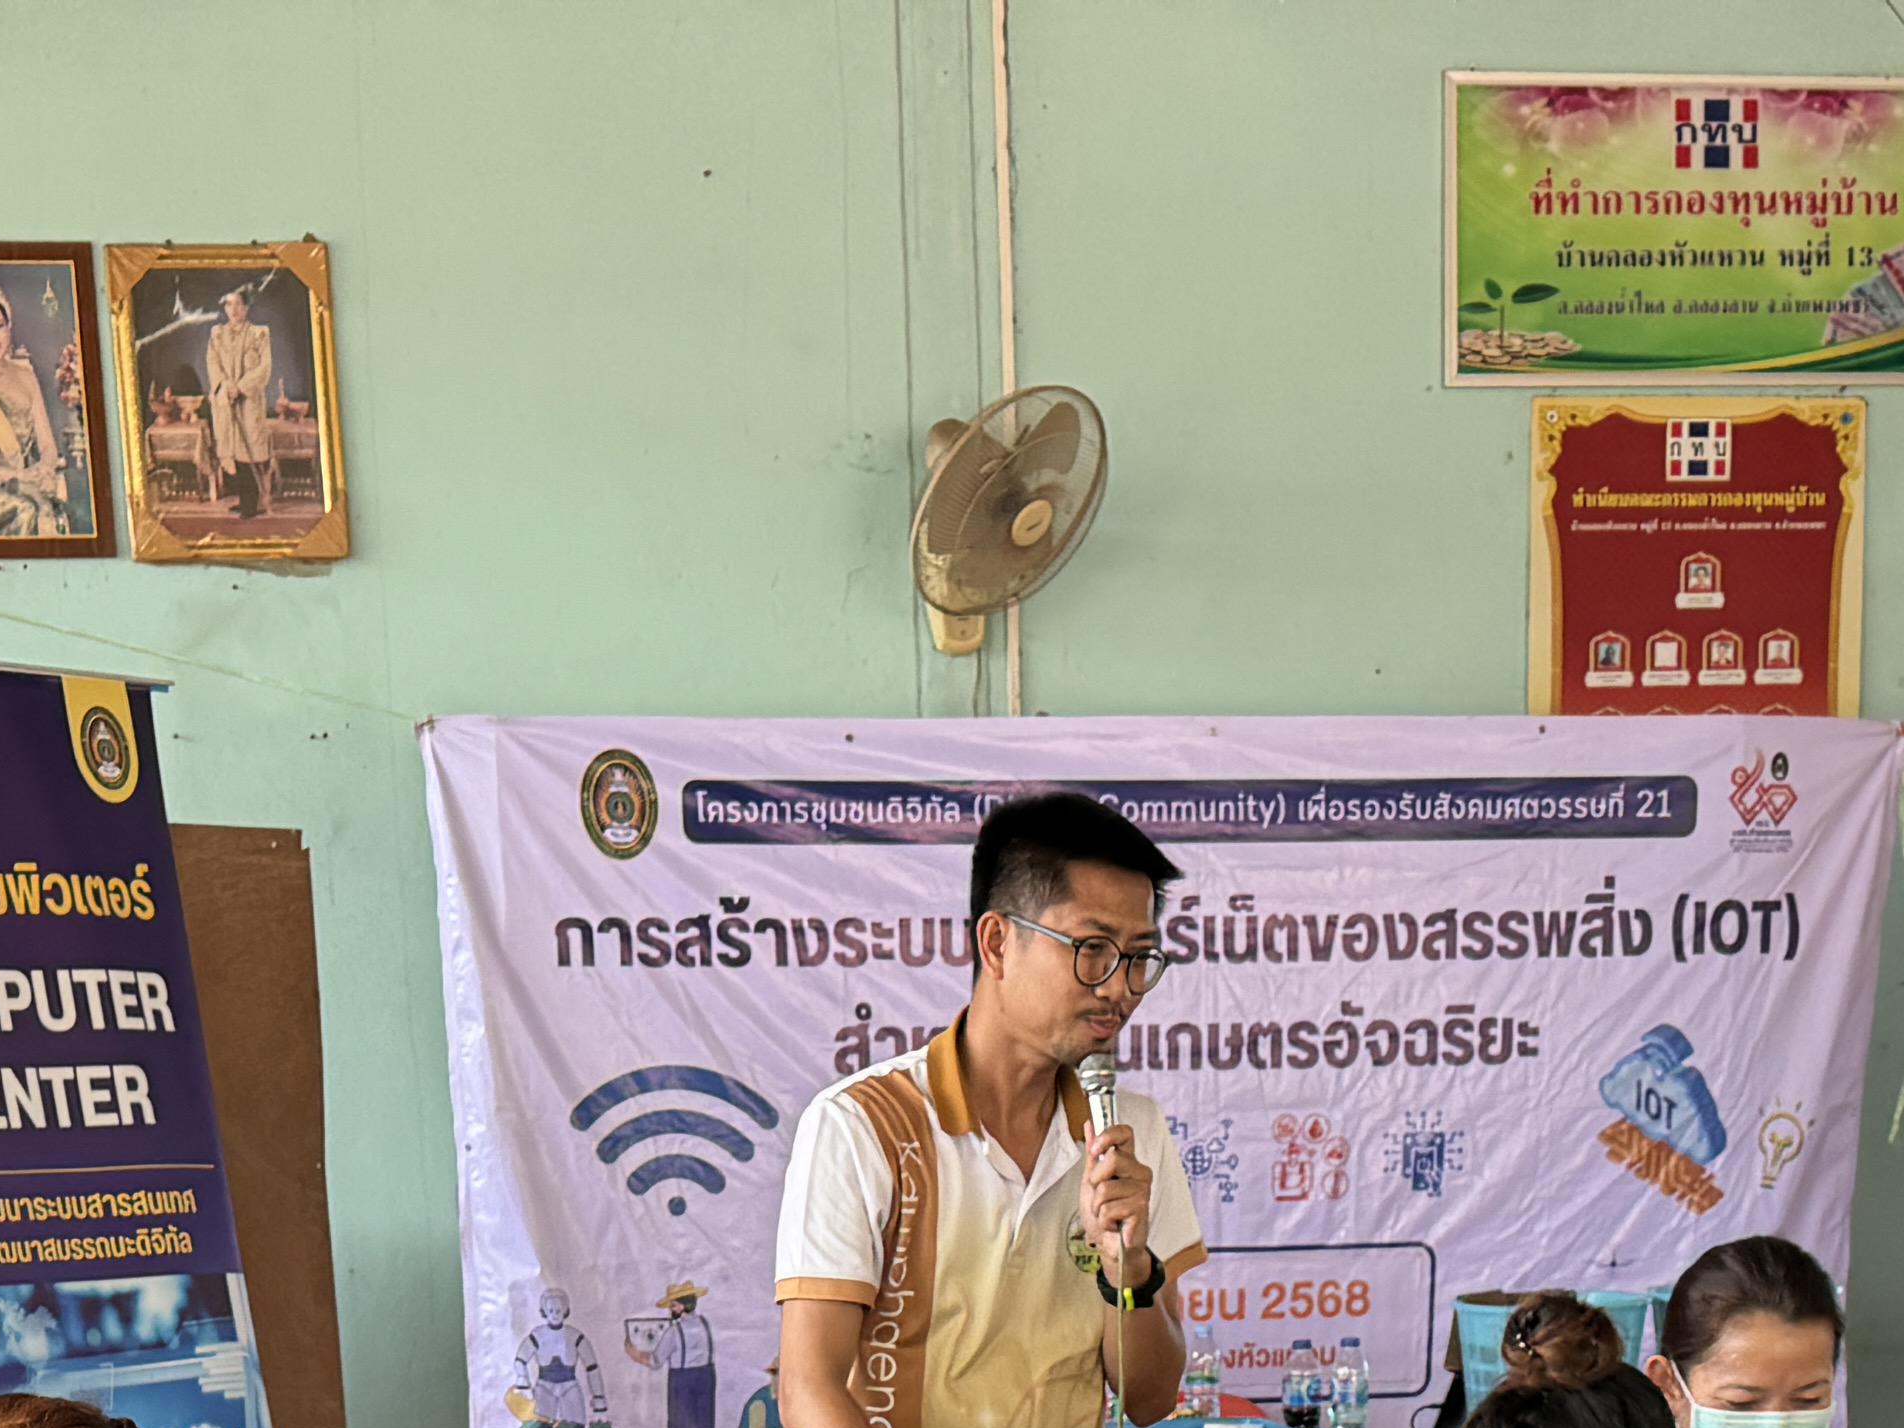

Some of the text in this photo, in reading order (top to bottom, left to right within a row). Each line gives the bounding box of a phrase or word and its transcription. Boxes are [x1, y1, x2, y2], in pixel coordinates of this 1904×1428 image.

[1528, 167, 1900, 228] ที่ทำการกองทุนหมู่บ้าน
[1556, 234, 1874, 276] บ้านคลองหัวแหวน หมู่ที่ 13
[1297, 786, 1626, 824] เพื่อรองรับสังคมศตวรรษที่
[1635, 790, 1673, 820] 21
[1670, 892, 1801, 964] (IOT)
[1259, 1279, 1372, 1321] 2568
